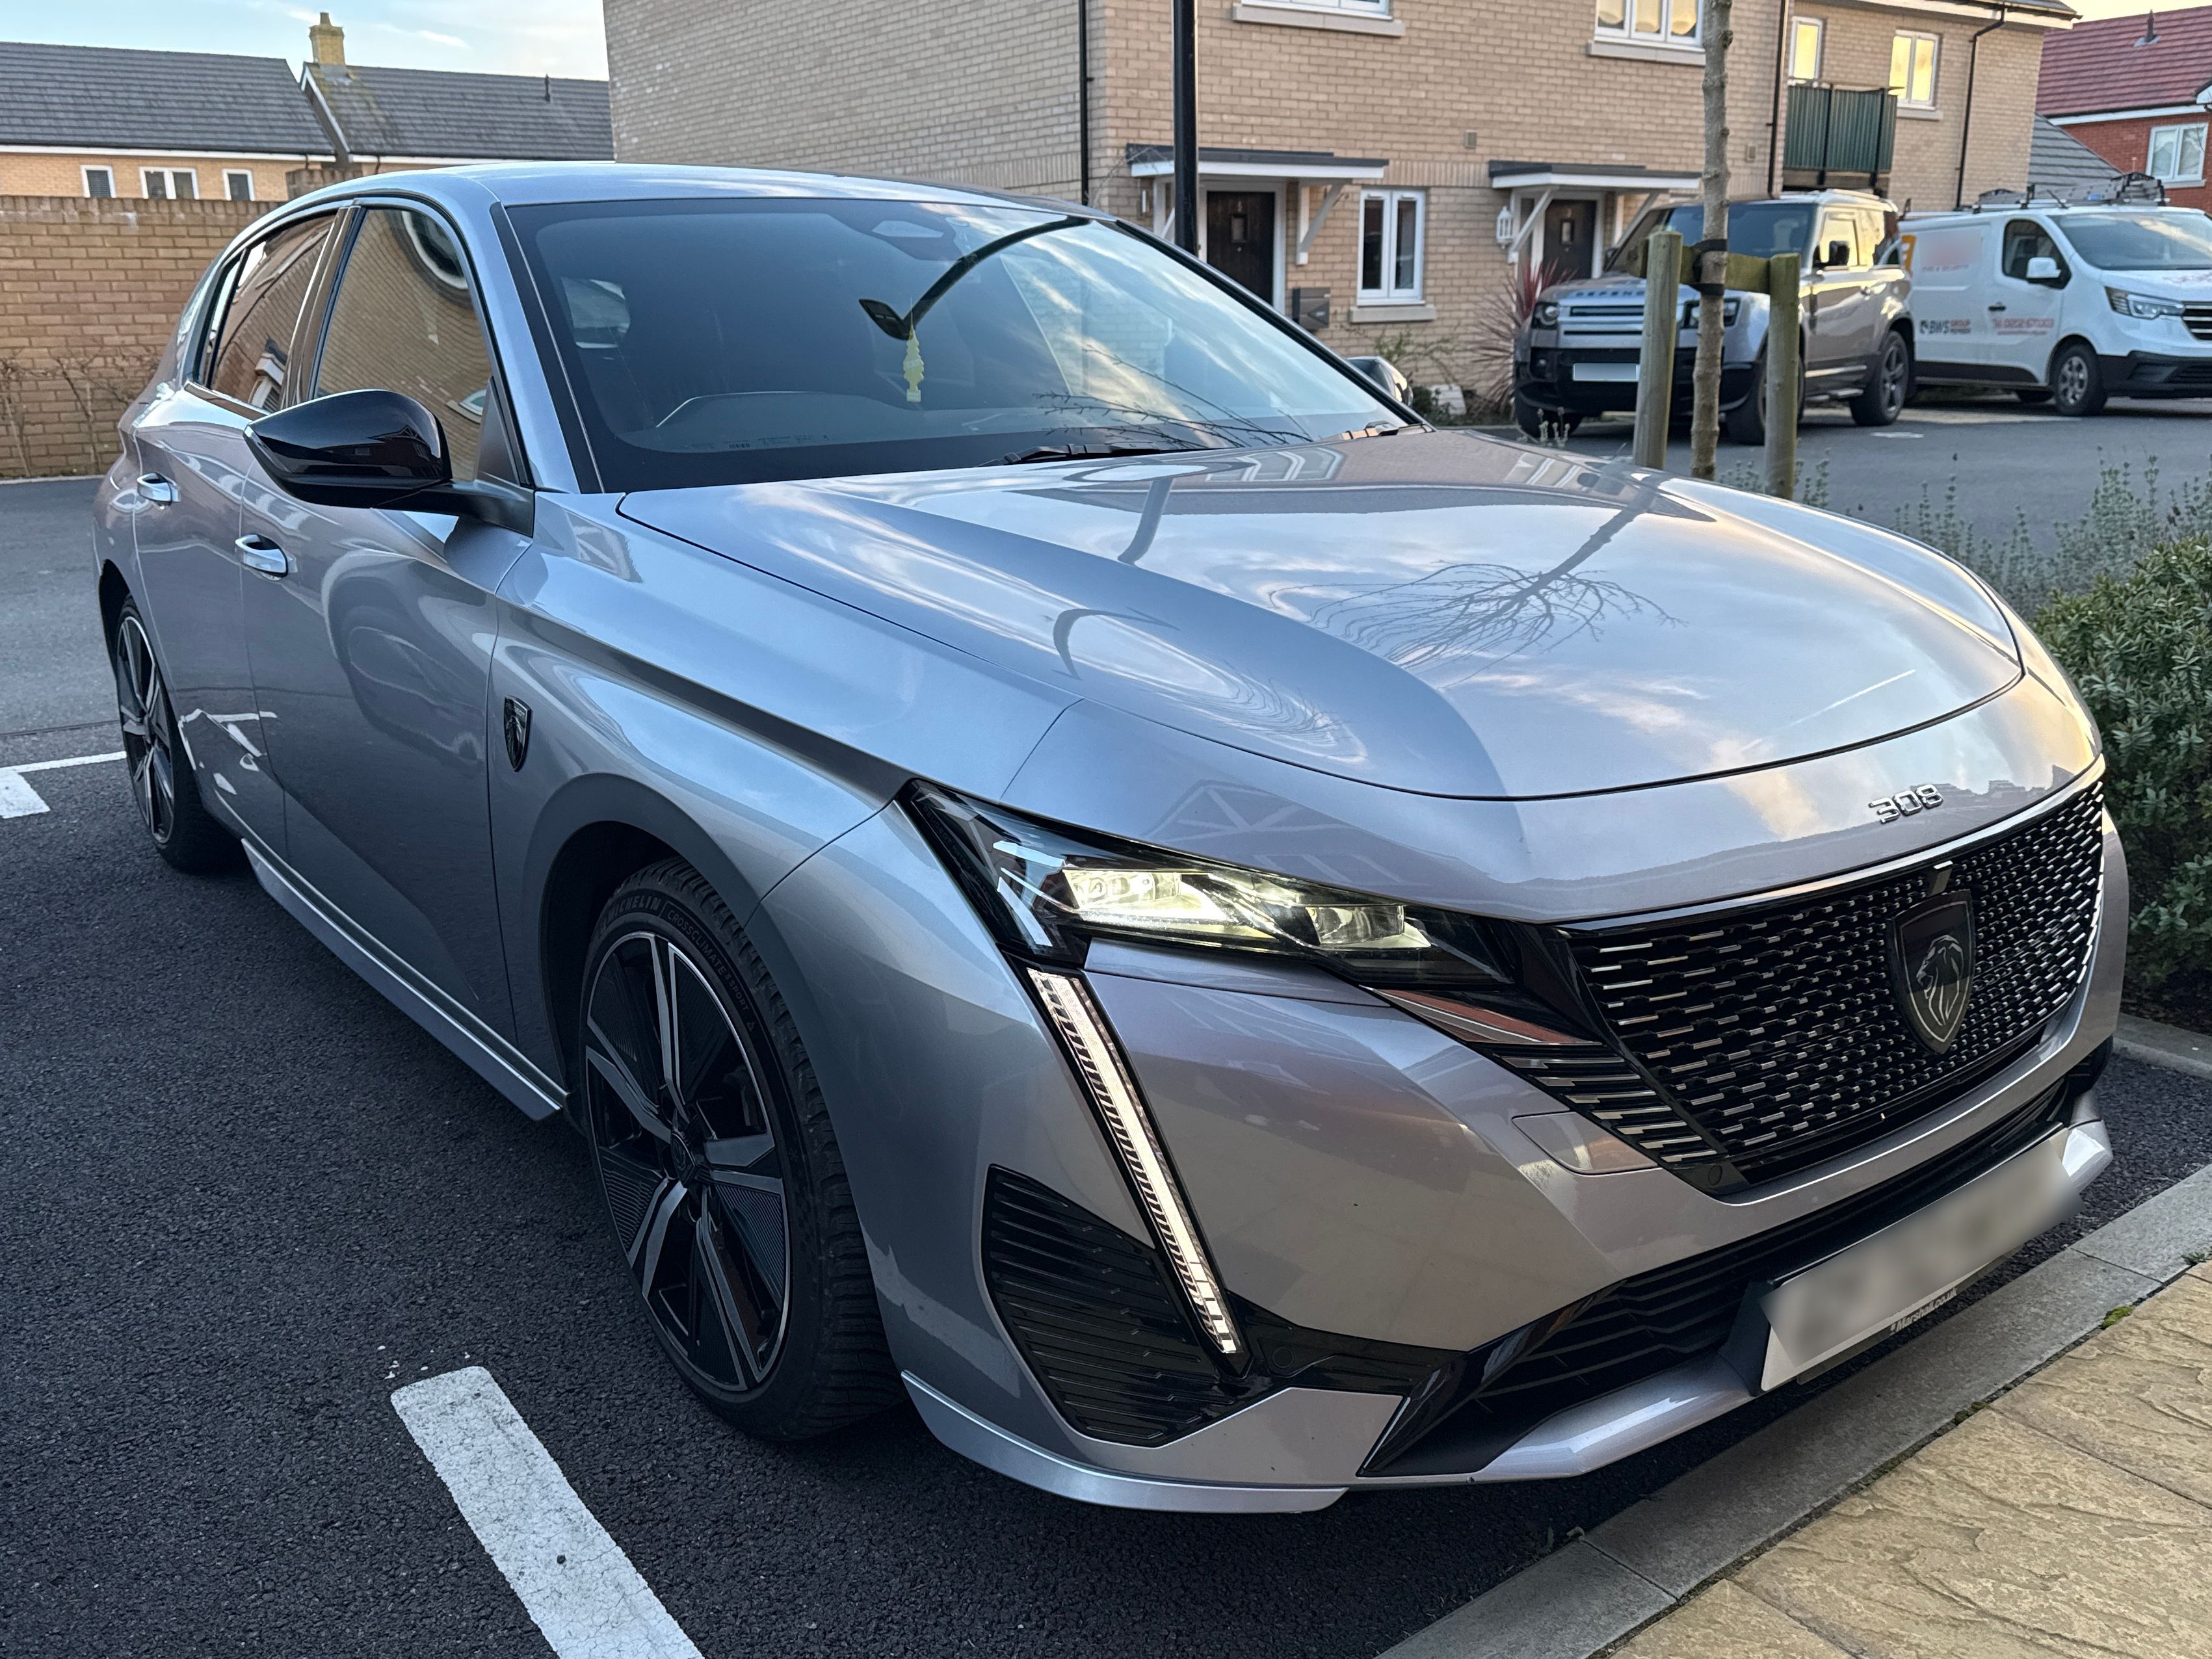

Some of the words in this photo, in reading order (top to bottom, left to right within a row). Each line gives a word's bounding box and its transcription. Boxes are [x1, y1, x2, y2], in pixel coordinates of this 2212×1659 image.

[1868, 784, 1943, 824] 308
[922, 805, 952, 844] PEUGEOT
[608, 895, 662, 923] MICHELIN
[667, 909, 727, 976] CROSSCLIMATE
[728, 980, 750, 1011] SPORT
[1896, 1287, 1957, 1332] Marshall.co.uk
